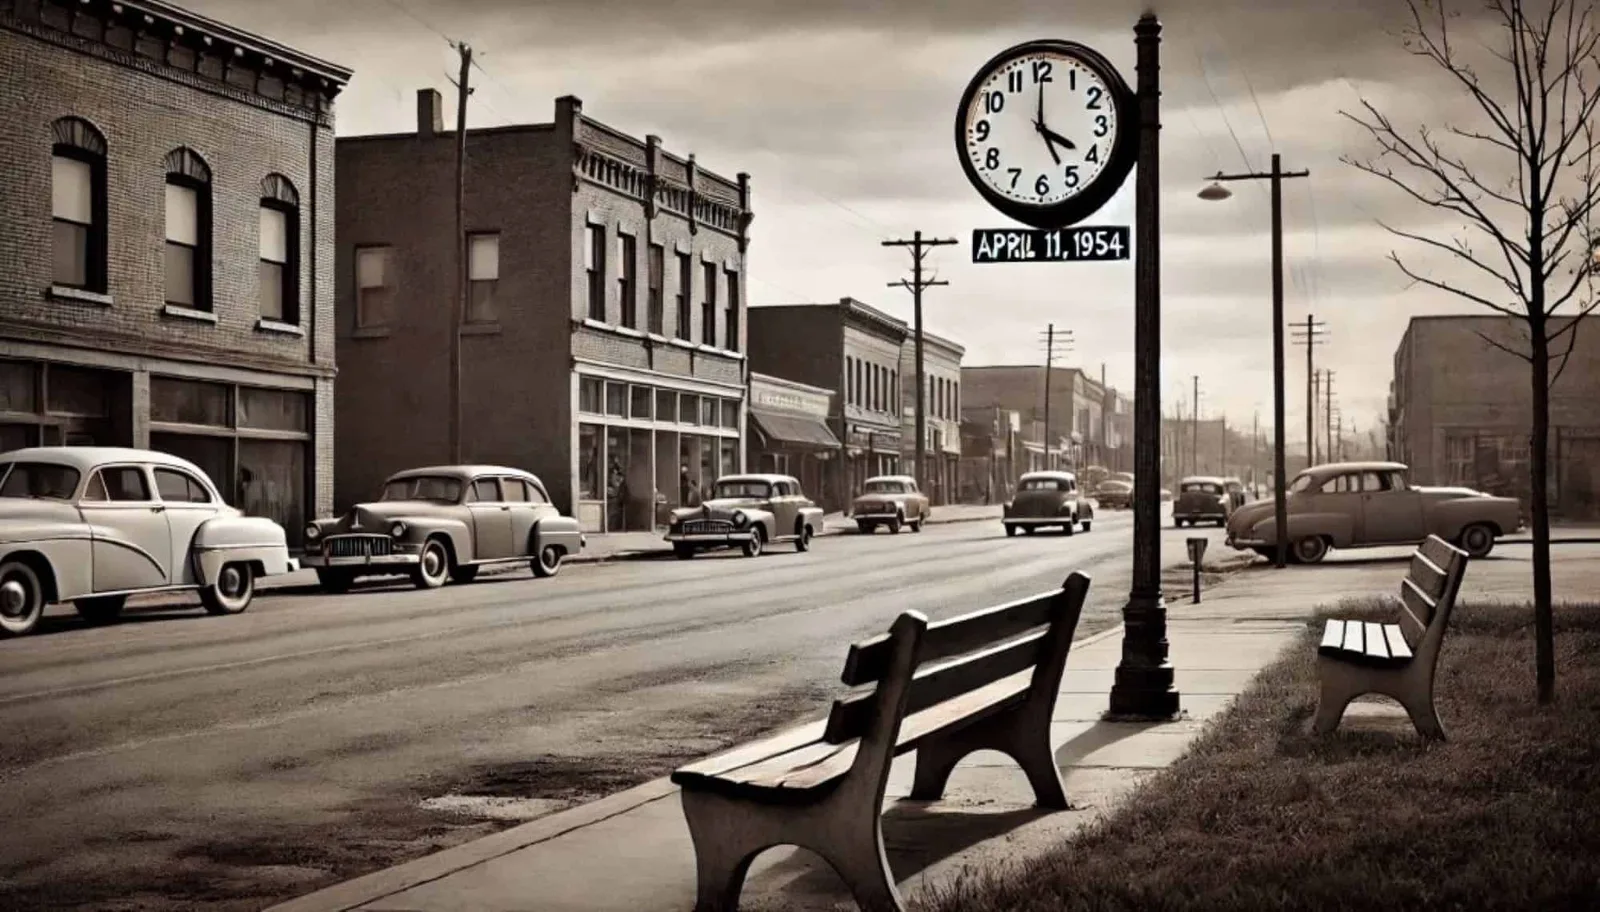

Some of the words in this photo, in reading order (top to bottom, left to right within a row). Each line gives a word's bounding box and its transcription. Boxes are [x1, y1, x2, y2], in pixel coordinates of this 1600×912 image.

[1008, 69, 1023, 94] 11
[1032, 61, 1053, 84] 12
[1069, 68, 1076, 91] 1
[984, 90, 1005, 115] 10
[1086, 86, 1103, 110] 2
[975, 119, 991, 142] 9
[1093, 114, 1109, 138] 3
[985, 147, 1000, 170] 8
[1084, 143, 1099, 165] 4
[1007, 167, 1022, 189] 7
[1034, 174, 1050, 196] 6
[1064, 165, 1080, 189] 5
[976, 232, 1036, 260] APRIL
[1073, 231, 1125, 258] 1954
